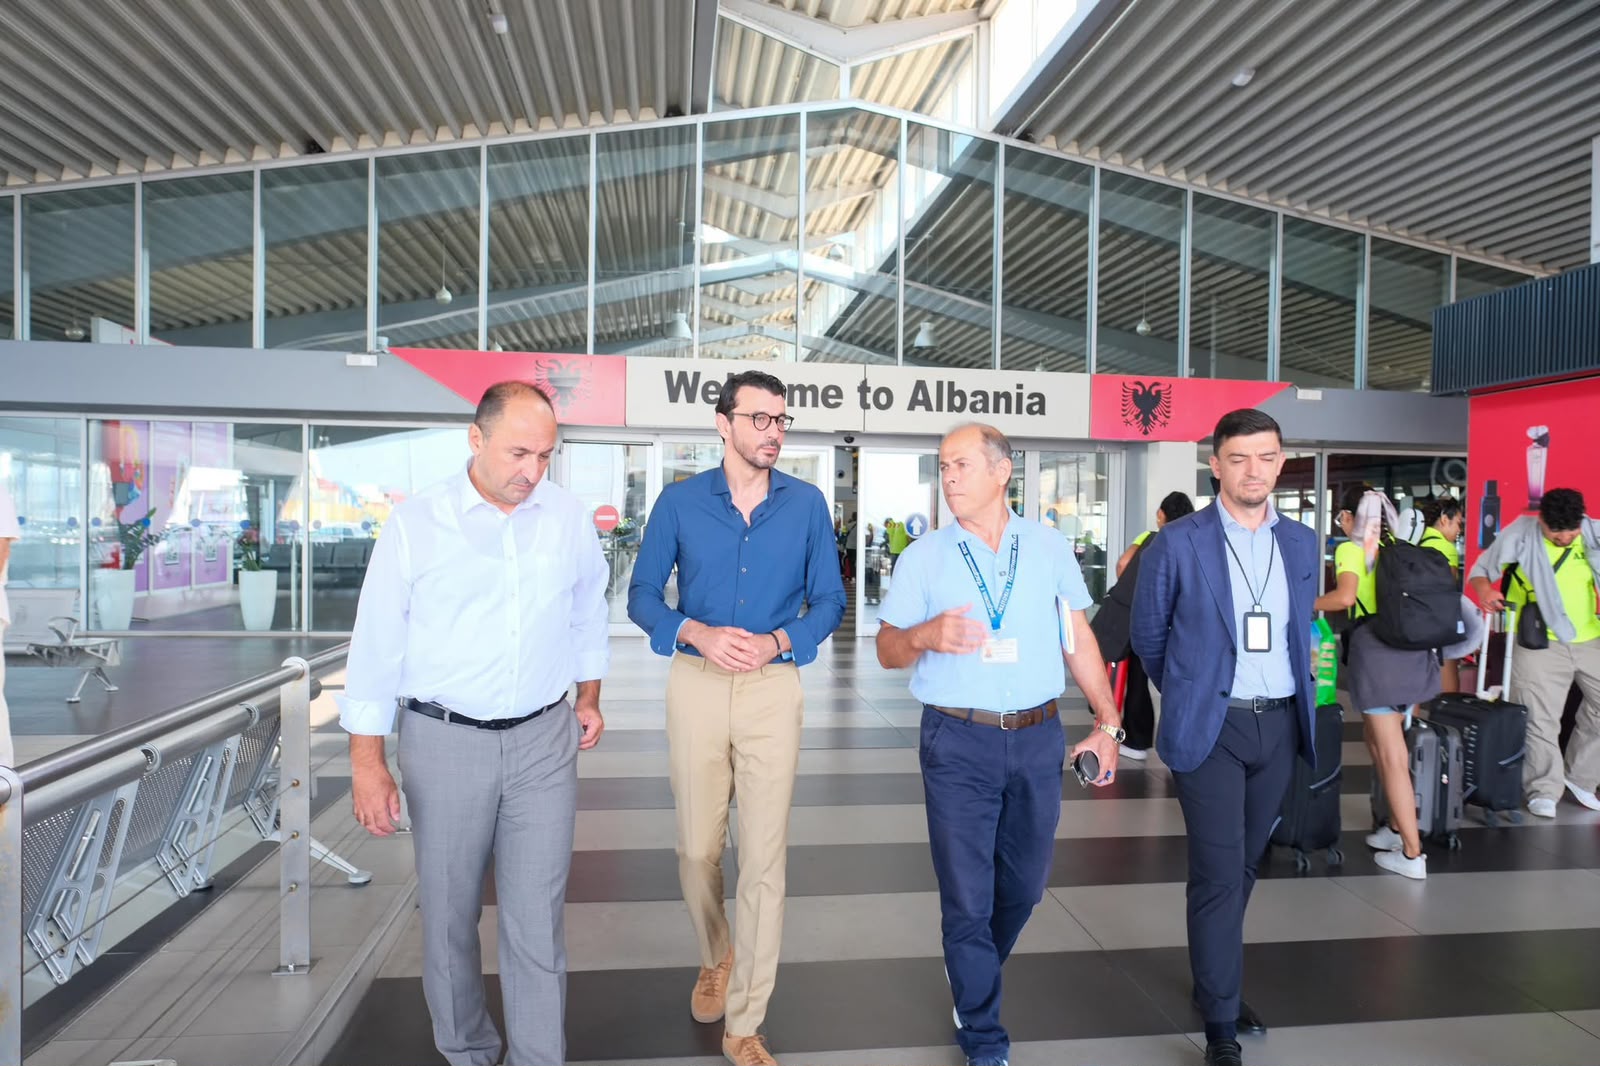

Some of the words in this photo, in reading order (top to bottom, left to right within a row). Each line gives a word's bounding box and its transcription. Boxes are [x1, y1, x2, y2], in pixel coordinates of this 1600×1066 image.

[664, 370, 844, 409] Weme
[857, 378, 894, 411] to
[907, 379, 1046, 416] Albania
